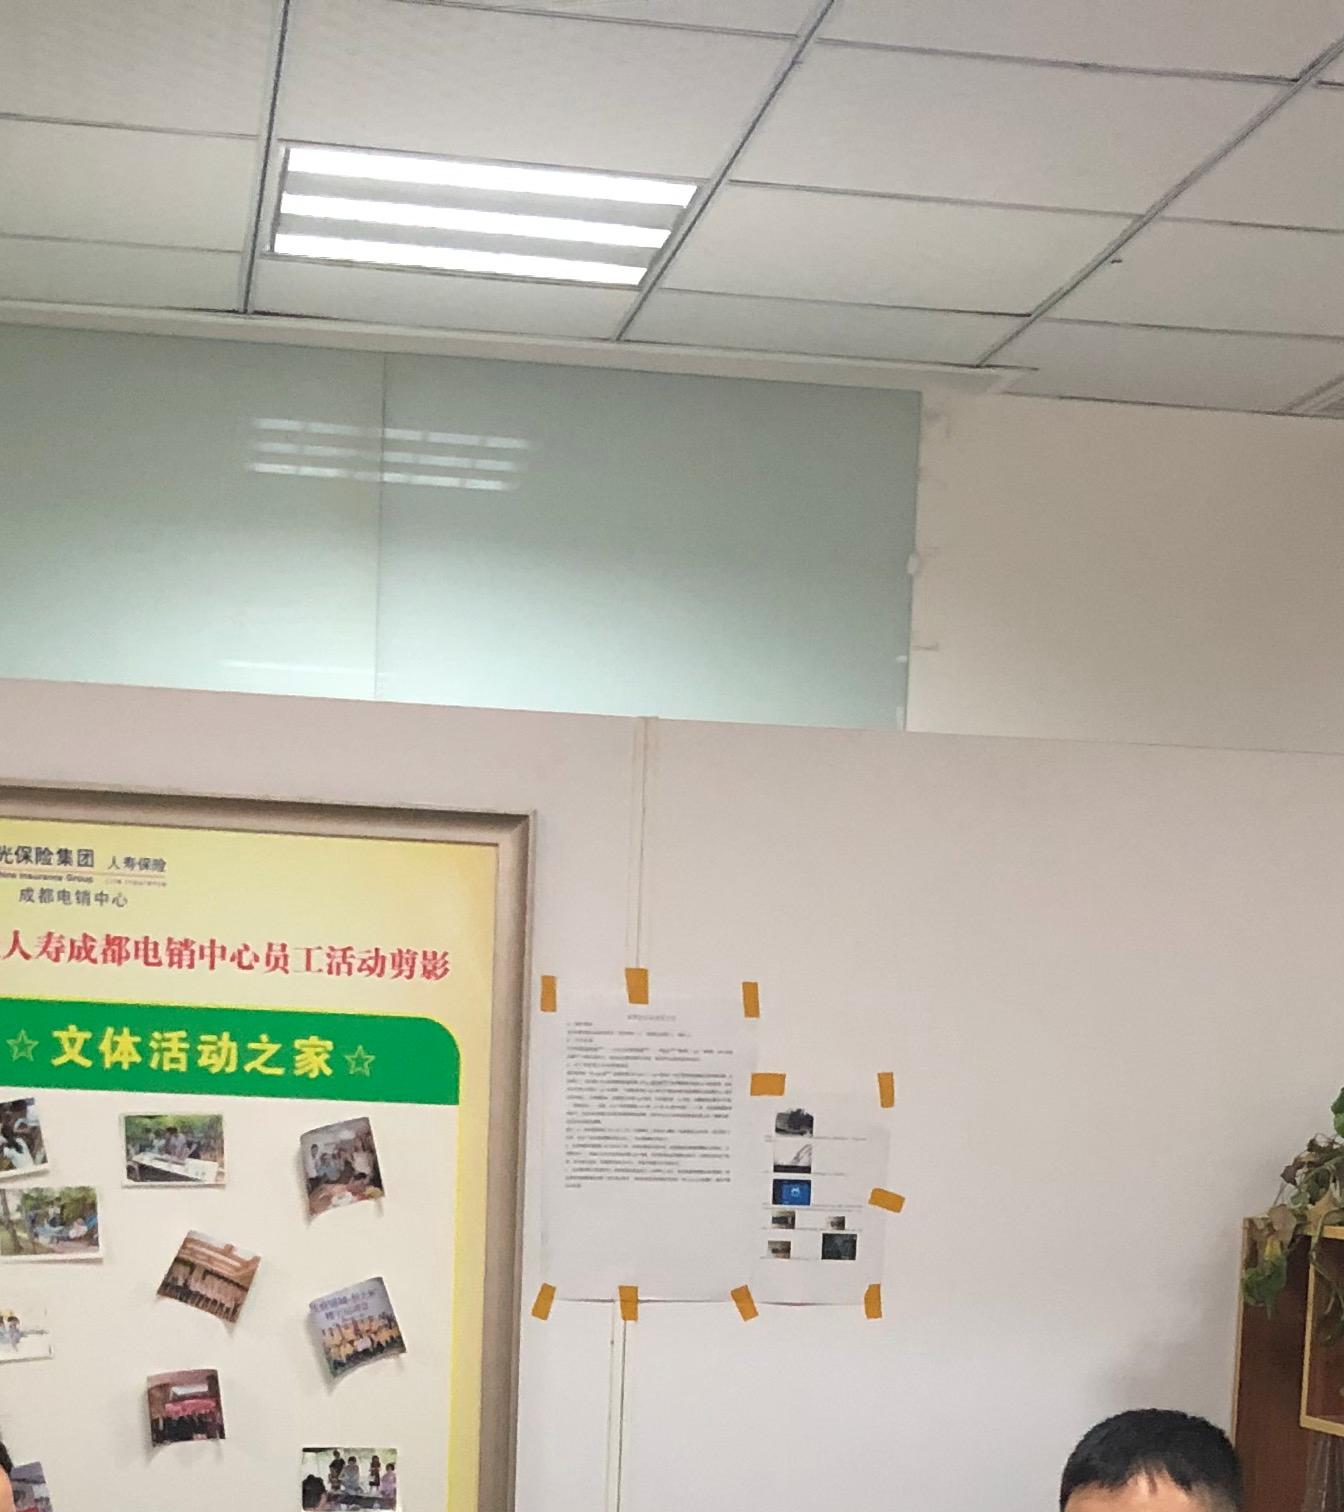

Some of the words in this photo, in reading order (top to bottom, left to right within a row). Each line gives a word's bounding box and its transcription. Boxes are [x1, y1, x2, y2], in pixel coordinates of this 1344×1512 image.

[107, 855, 167, 873] 人寿保险
[66, 874, 93, 884] Group
[19, 887, 128, 908] 成都电销中心
[52, 1025, 335, 1080] 文体活动之家
